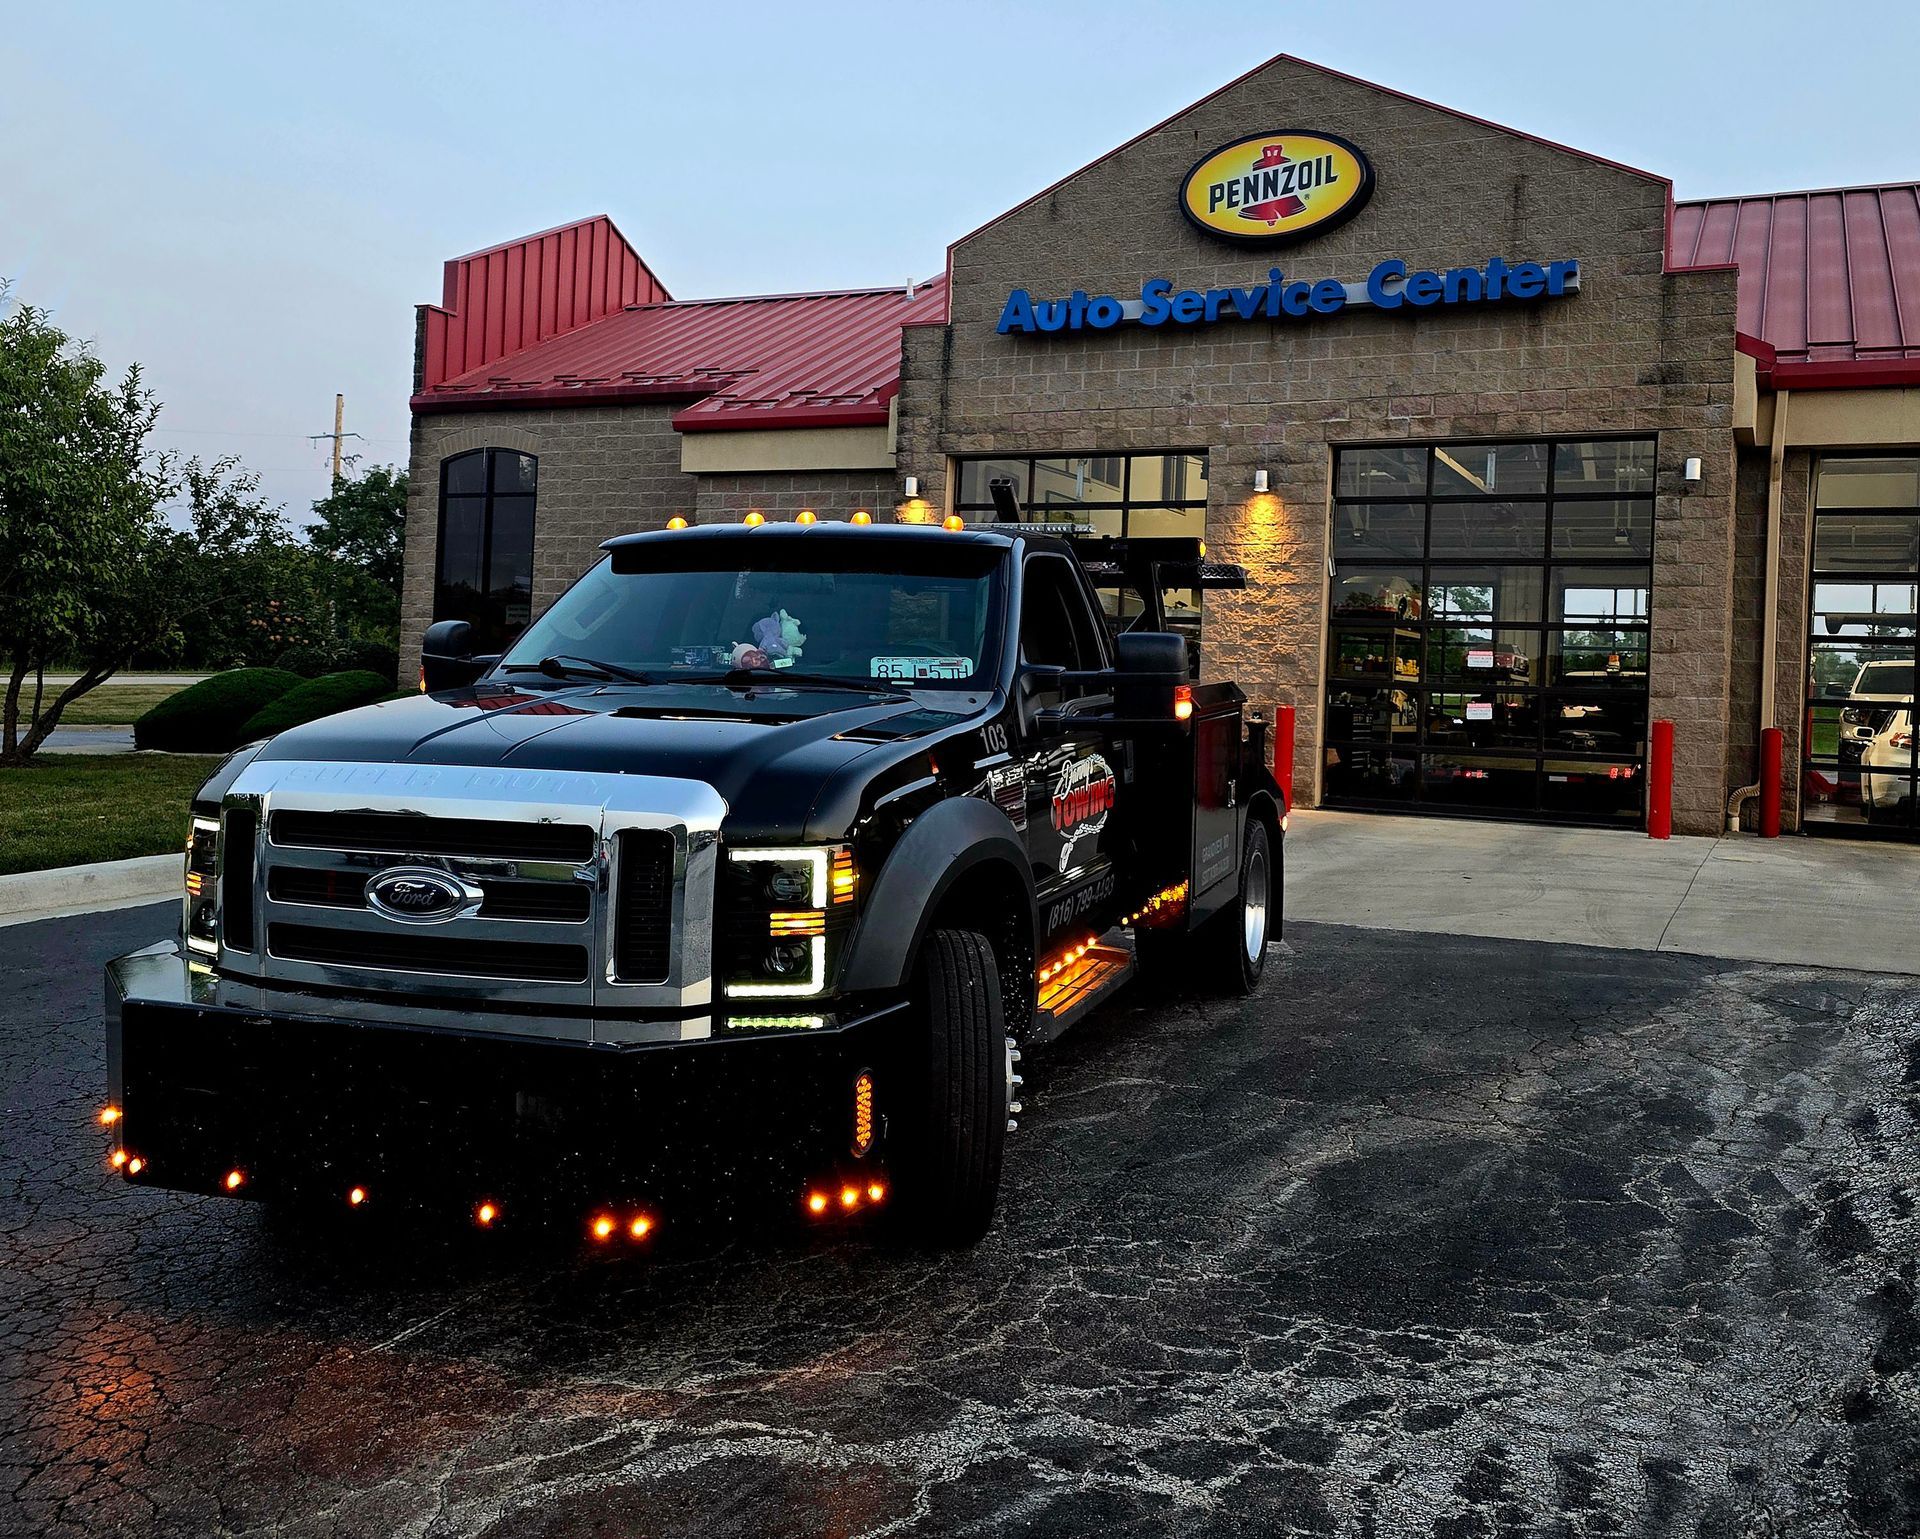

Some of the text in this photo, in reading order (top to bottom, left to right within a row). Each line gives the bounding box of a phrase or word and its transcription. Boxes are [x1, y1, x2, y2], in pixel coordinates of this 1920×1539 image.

[1209, 154, 1338, 214] PENNZOIL
[996, 256, 1579, 335] Auto Service Center
[980, 723, 1008, 754] 103
[287, 765, 603, 797] SUPER DUTY
[1053, 775, 1115, 831] TOWING
[389, 880, 438, 908] Ford
